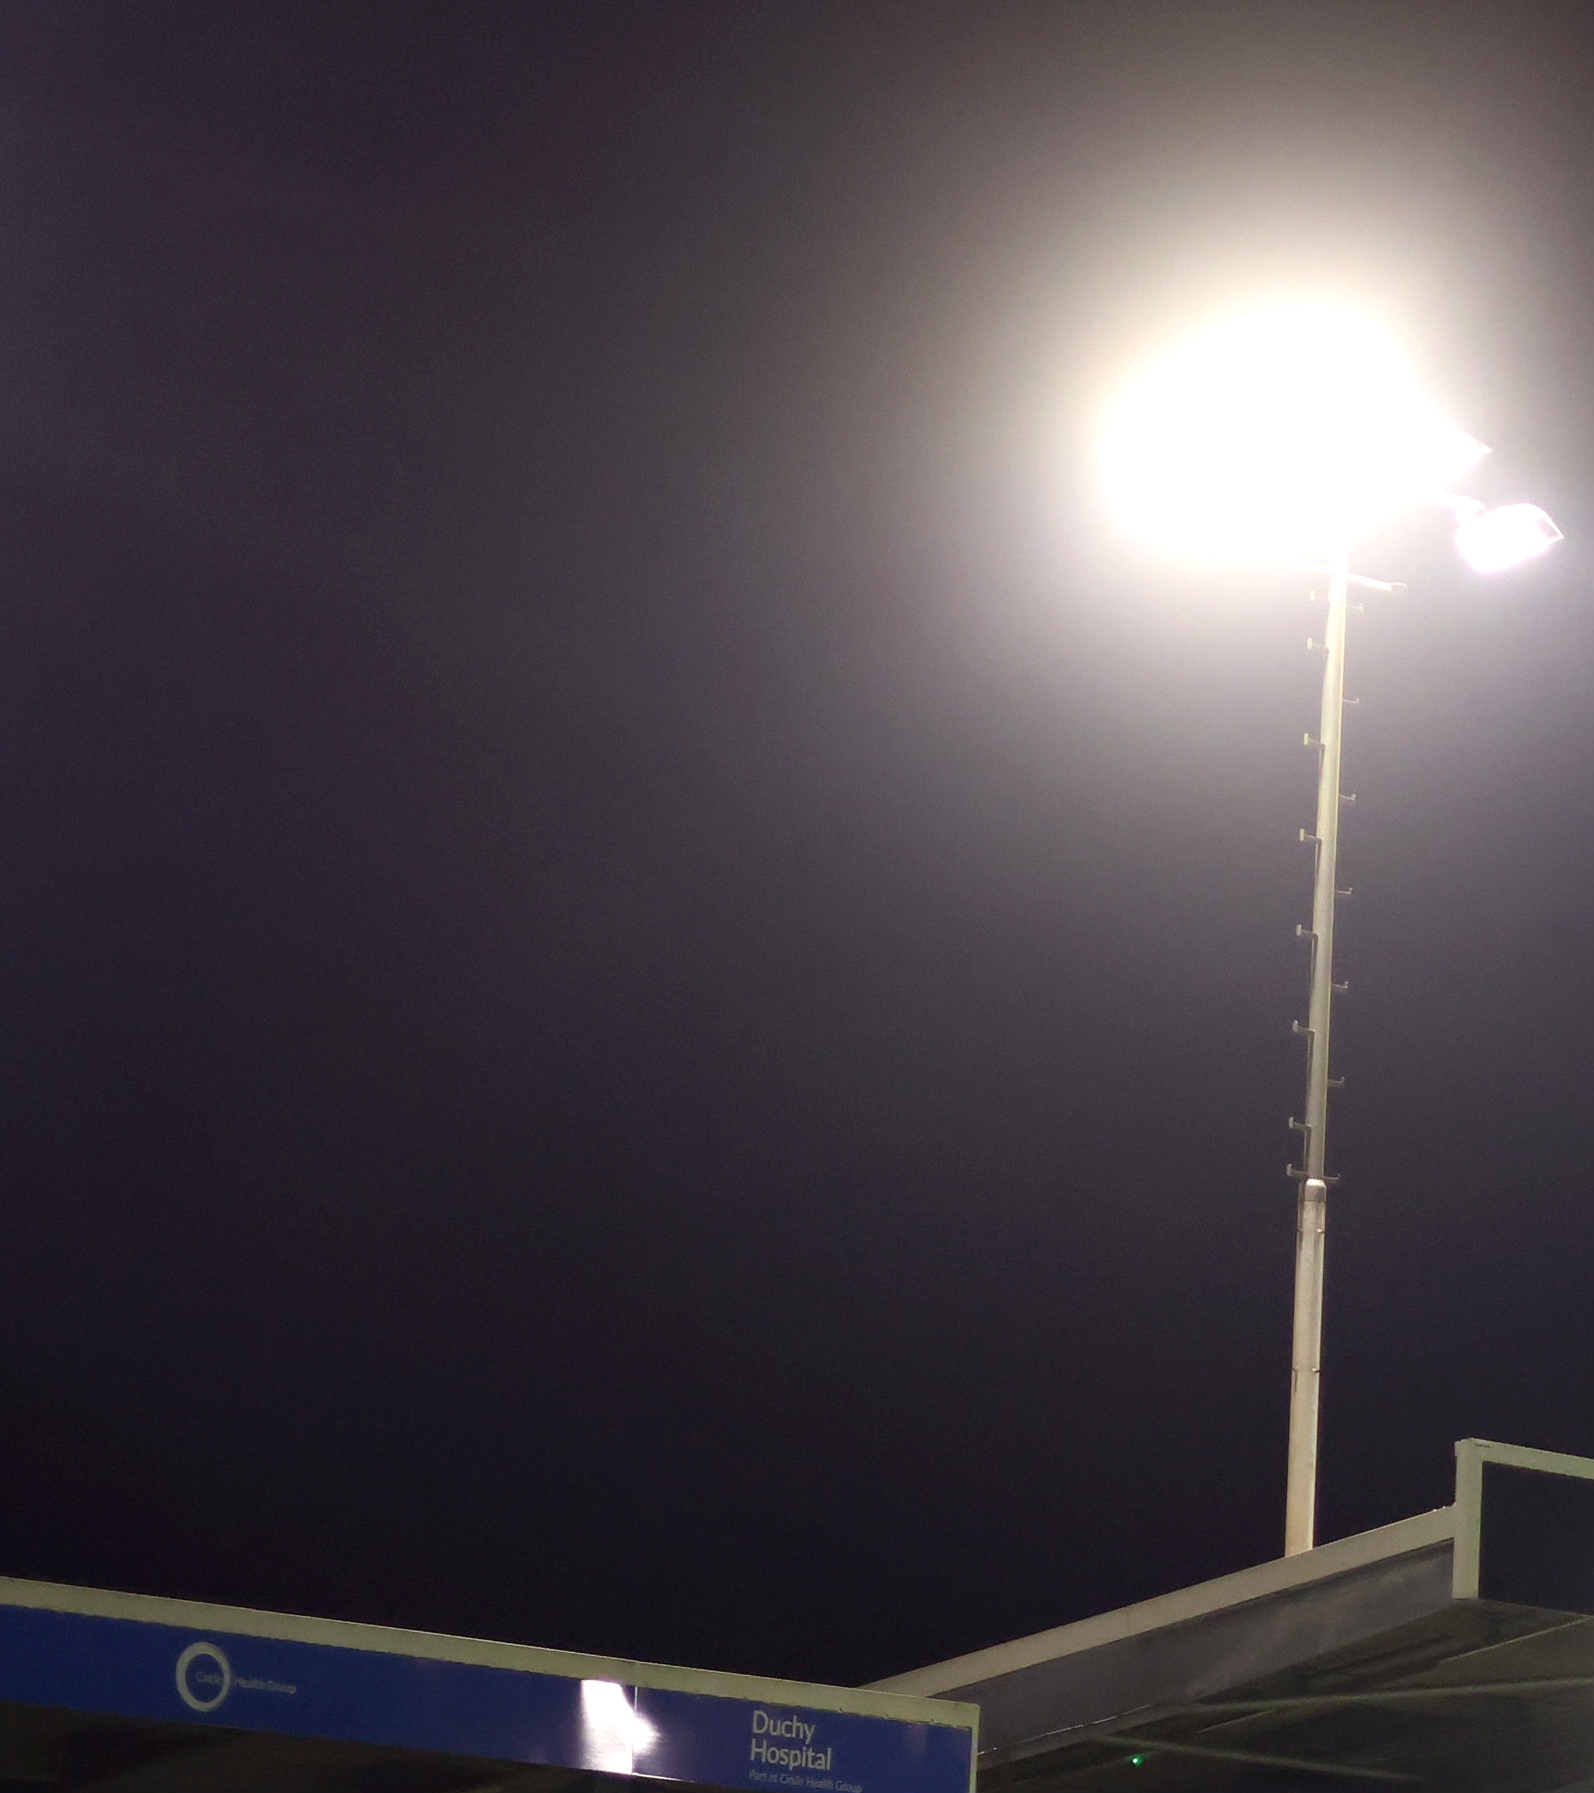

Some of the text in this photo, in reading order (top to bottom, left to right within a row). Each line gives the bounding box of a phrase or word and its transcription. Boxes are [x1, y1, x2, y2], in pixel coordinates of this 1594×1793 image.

[752, 1709, 816, 1745] Duchy
[750, 1737, 832, 1770] Hospital
[749, 1769, 767, 1782] Part
[769, 1772, 779, 1783] of
